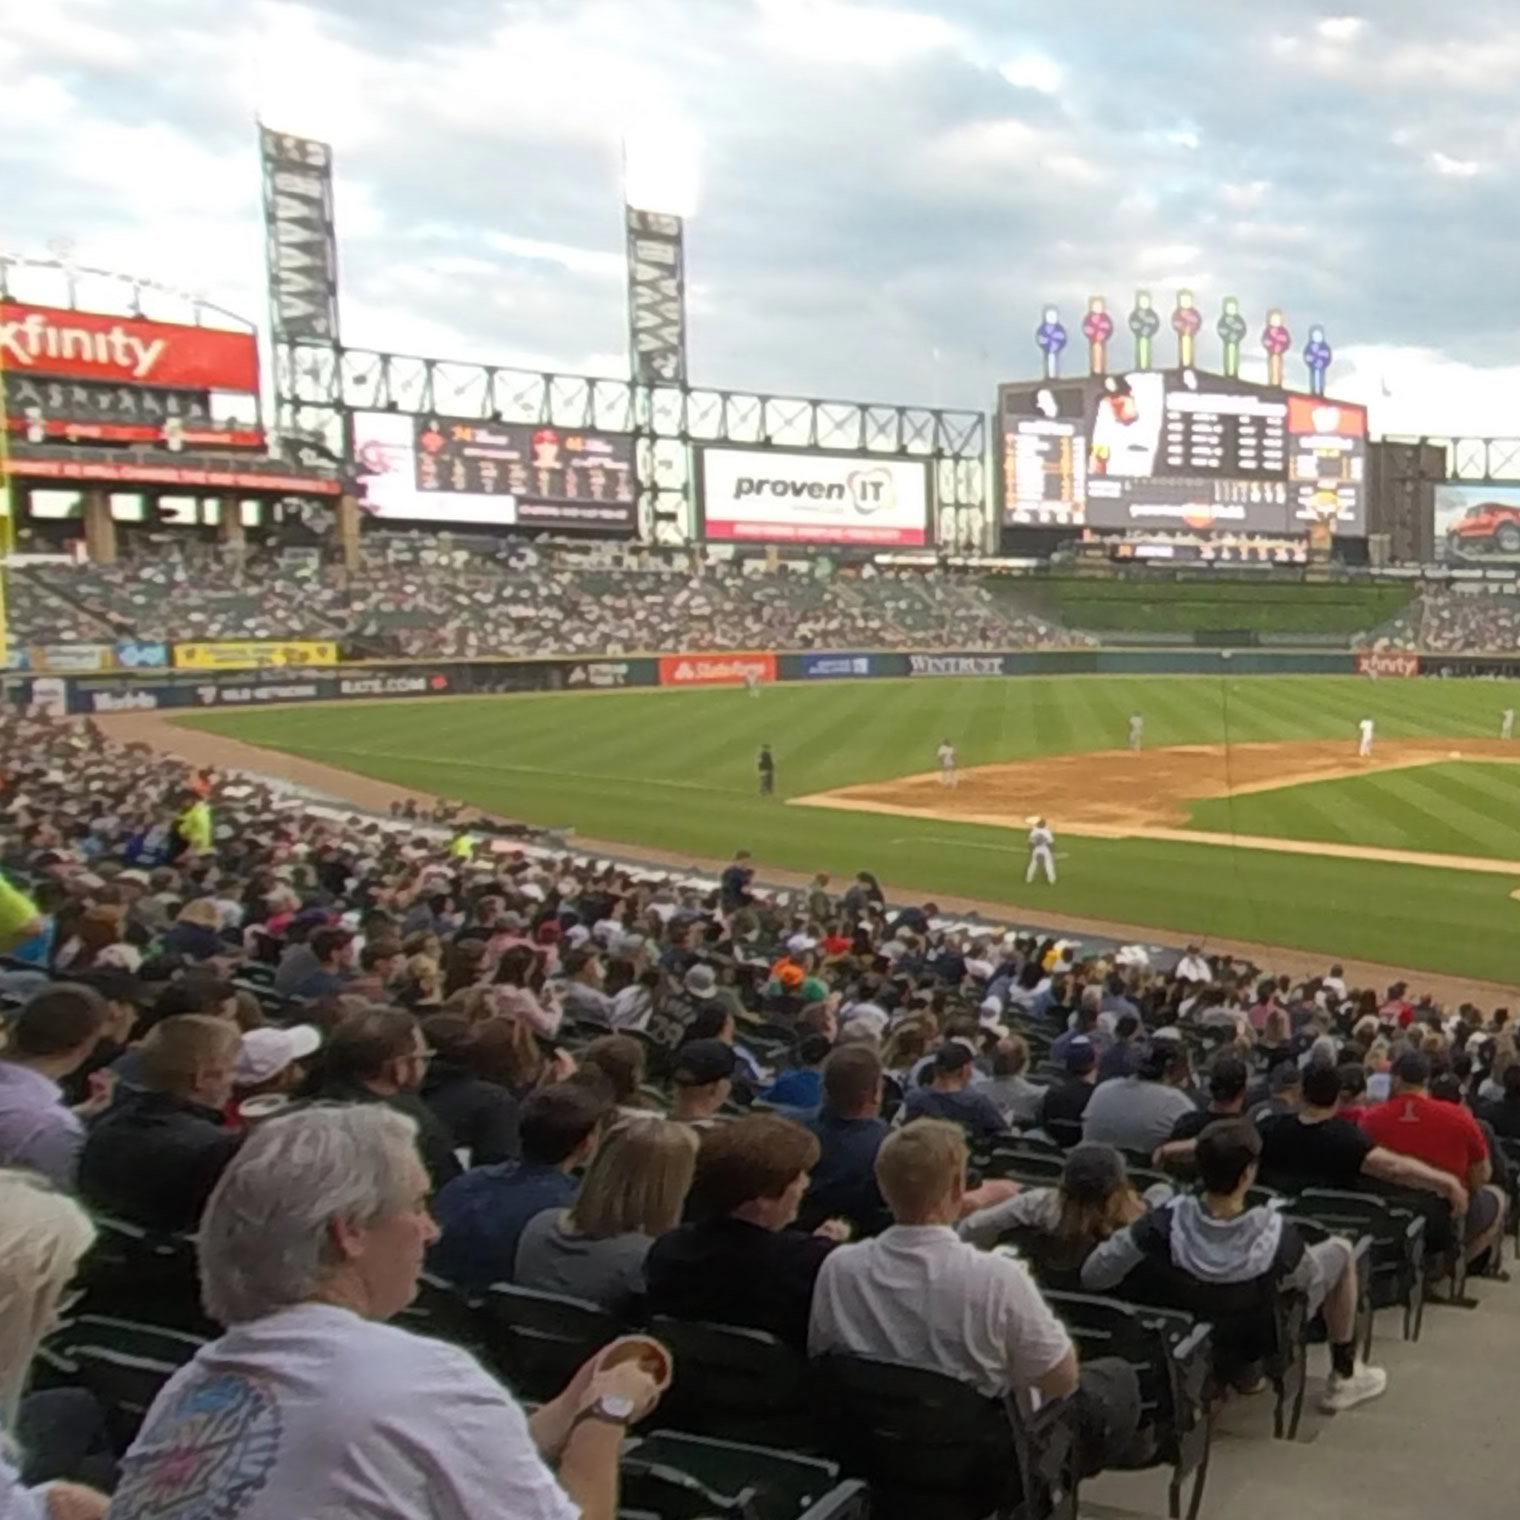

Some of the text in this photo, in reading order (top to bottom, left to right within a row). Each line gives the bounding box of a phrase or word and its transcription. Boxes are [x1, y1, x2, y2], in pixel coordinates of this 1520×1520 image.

[733, 477, 885, 501] proven IT
[908, 654, 1005, 674] WINTRUST
